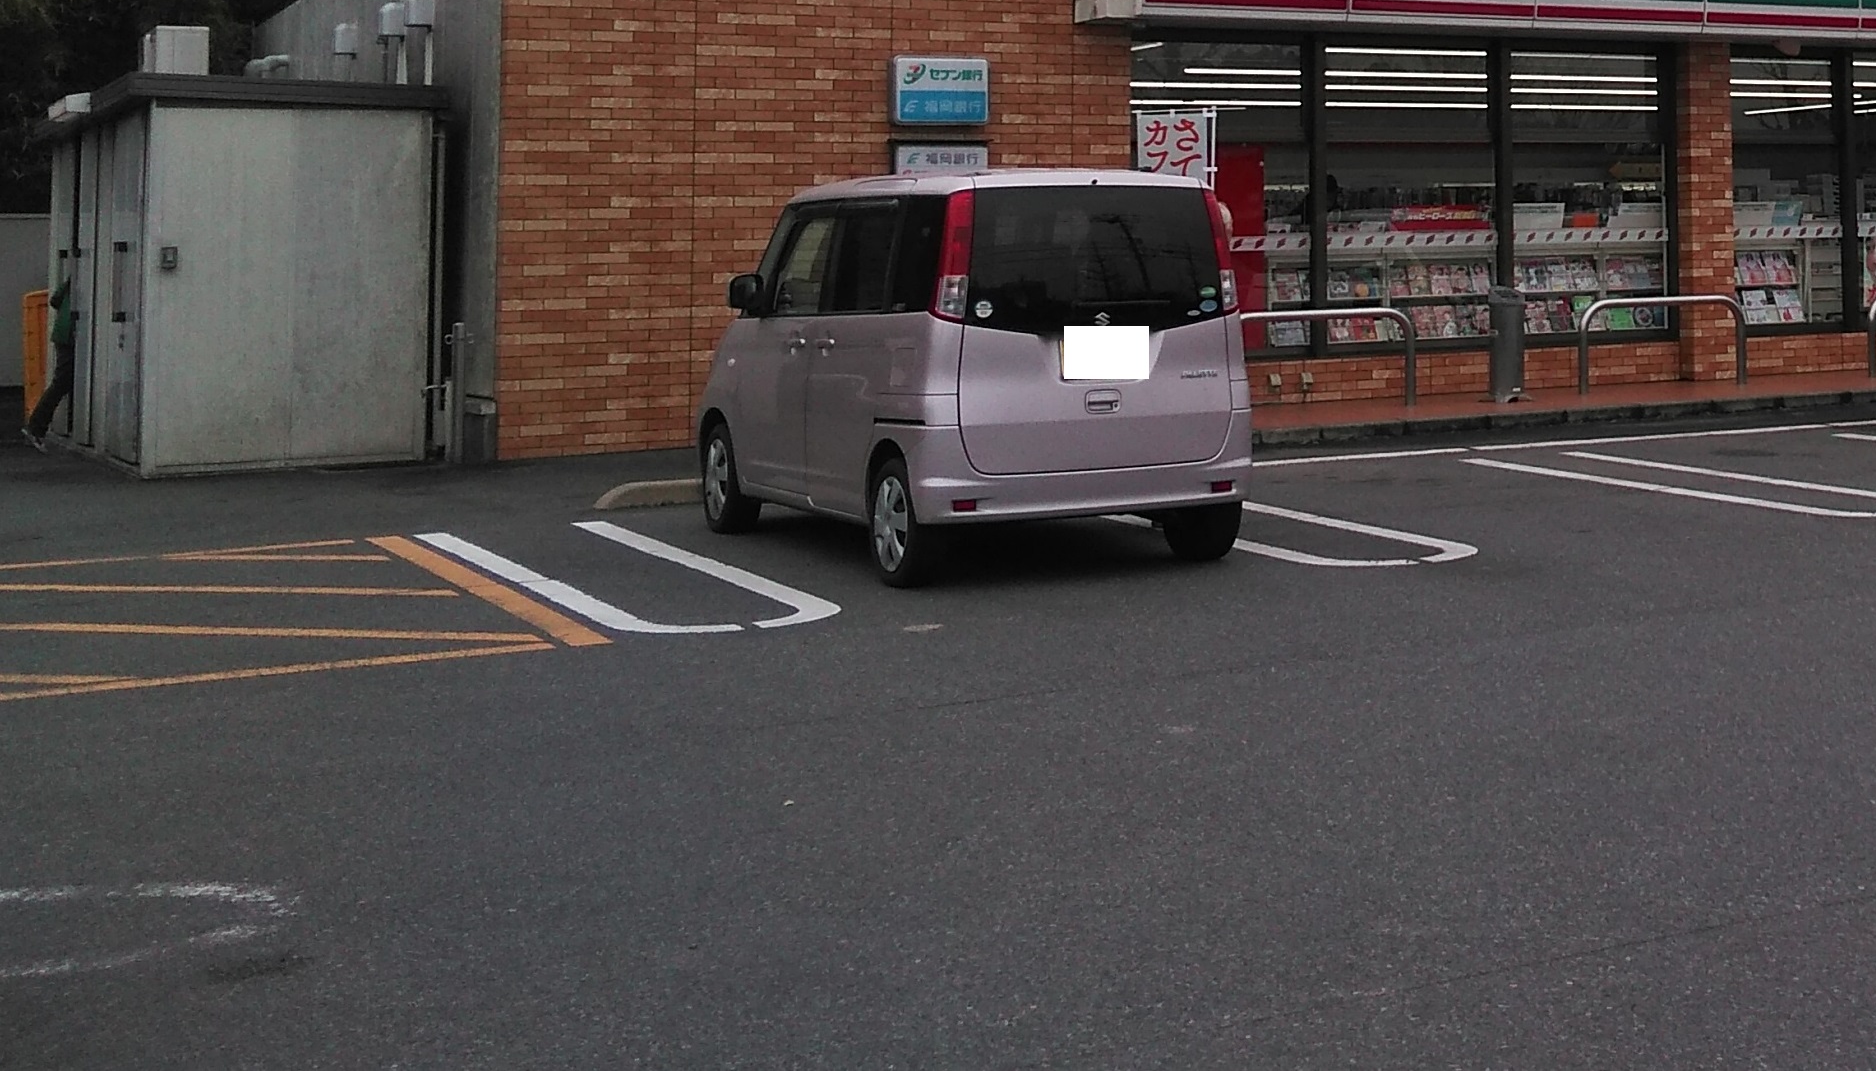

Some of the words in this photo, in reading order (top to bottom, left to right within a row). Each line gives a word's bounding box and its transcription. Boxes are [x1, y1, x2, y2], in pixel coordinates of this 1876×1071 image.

[929, 68, 983, 81] セブン銀行
[925, 101, 981, 113] 福岡銀行
[926, 153, 979, 165] 福岡銀行
